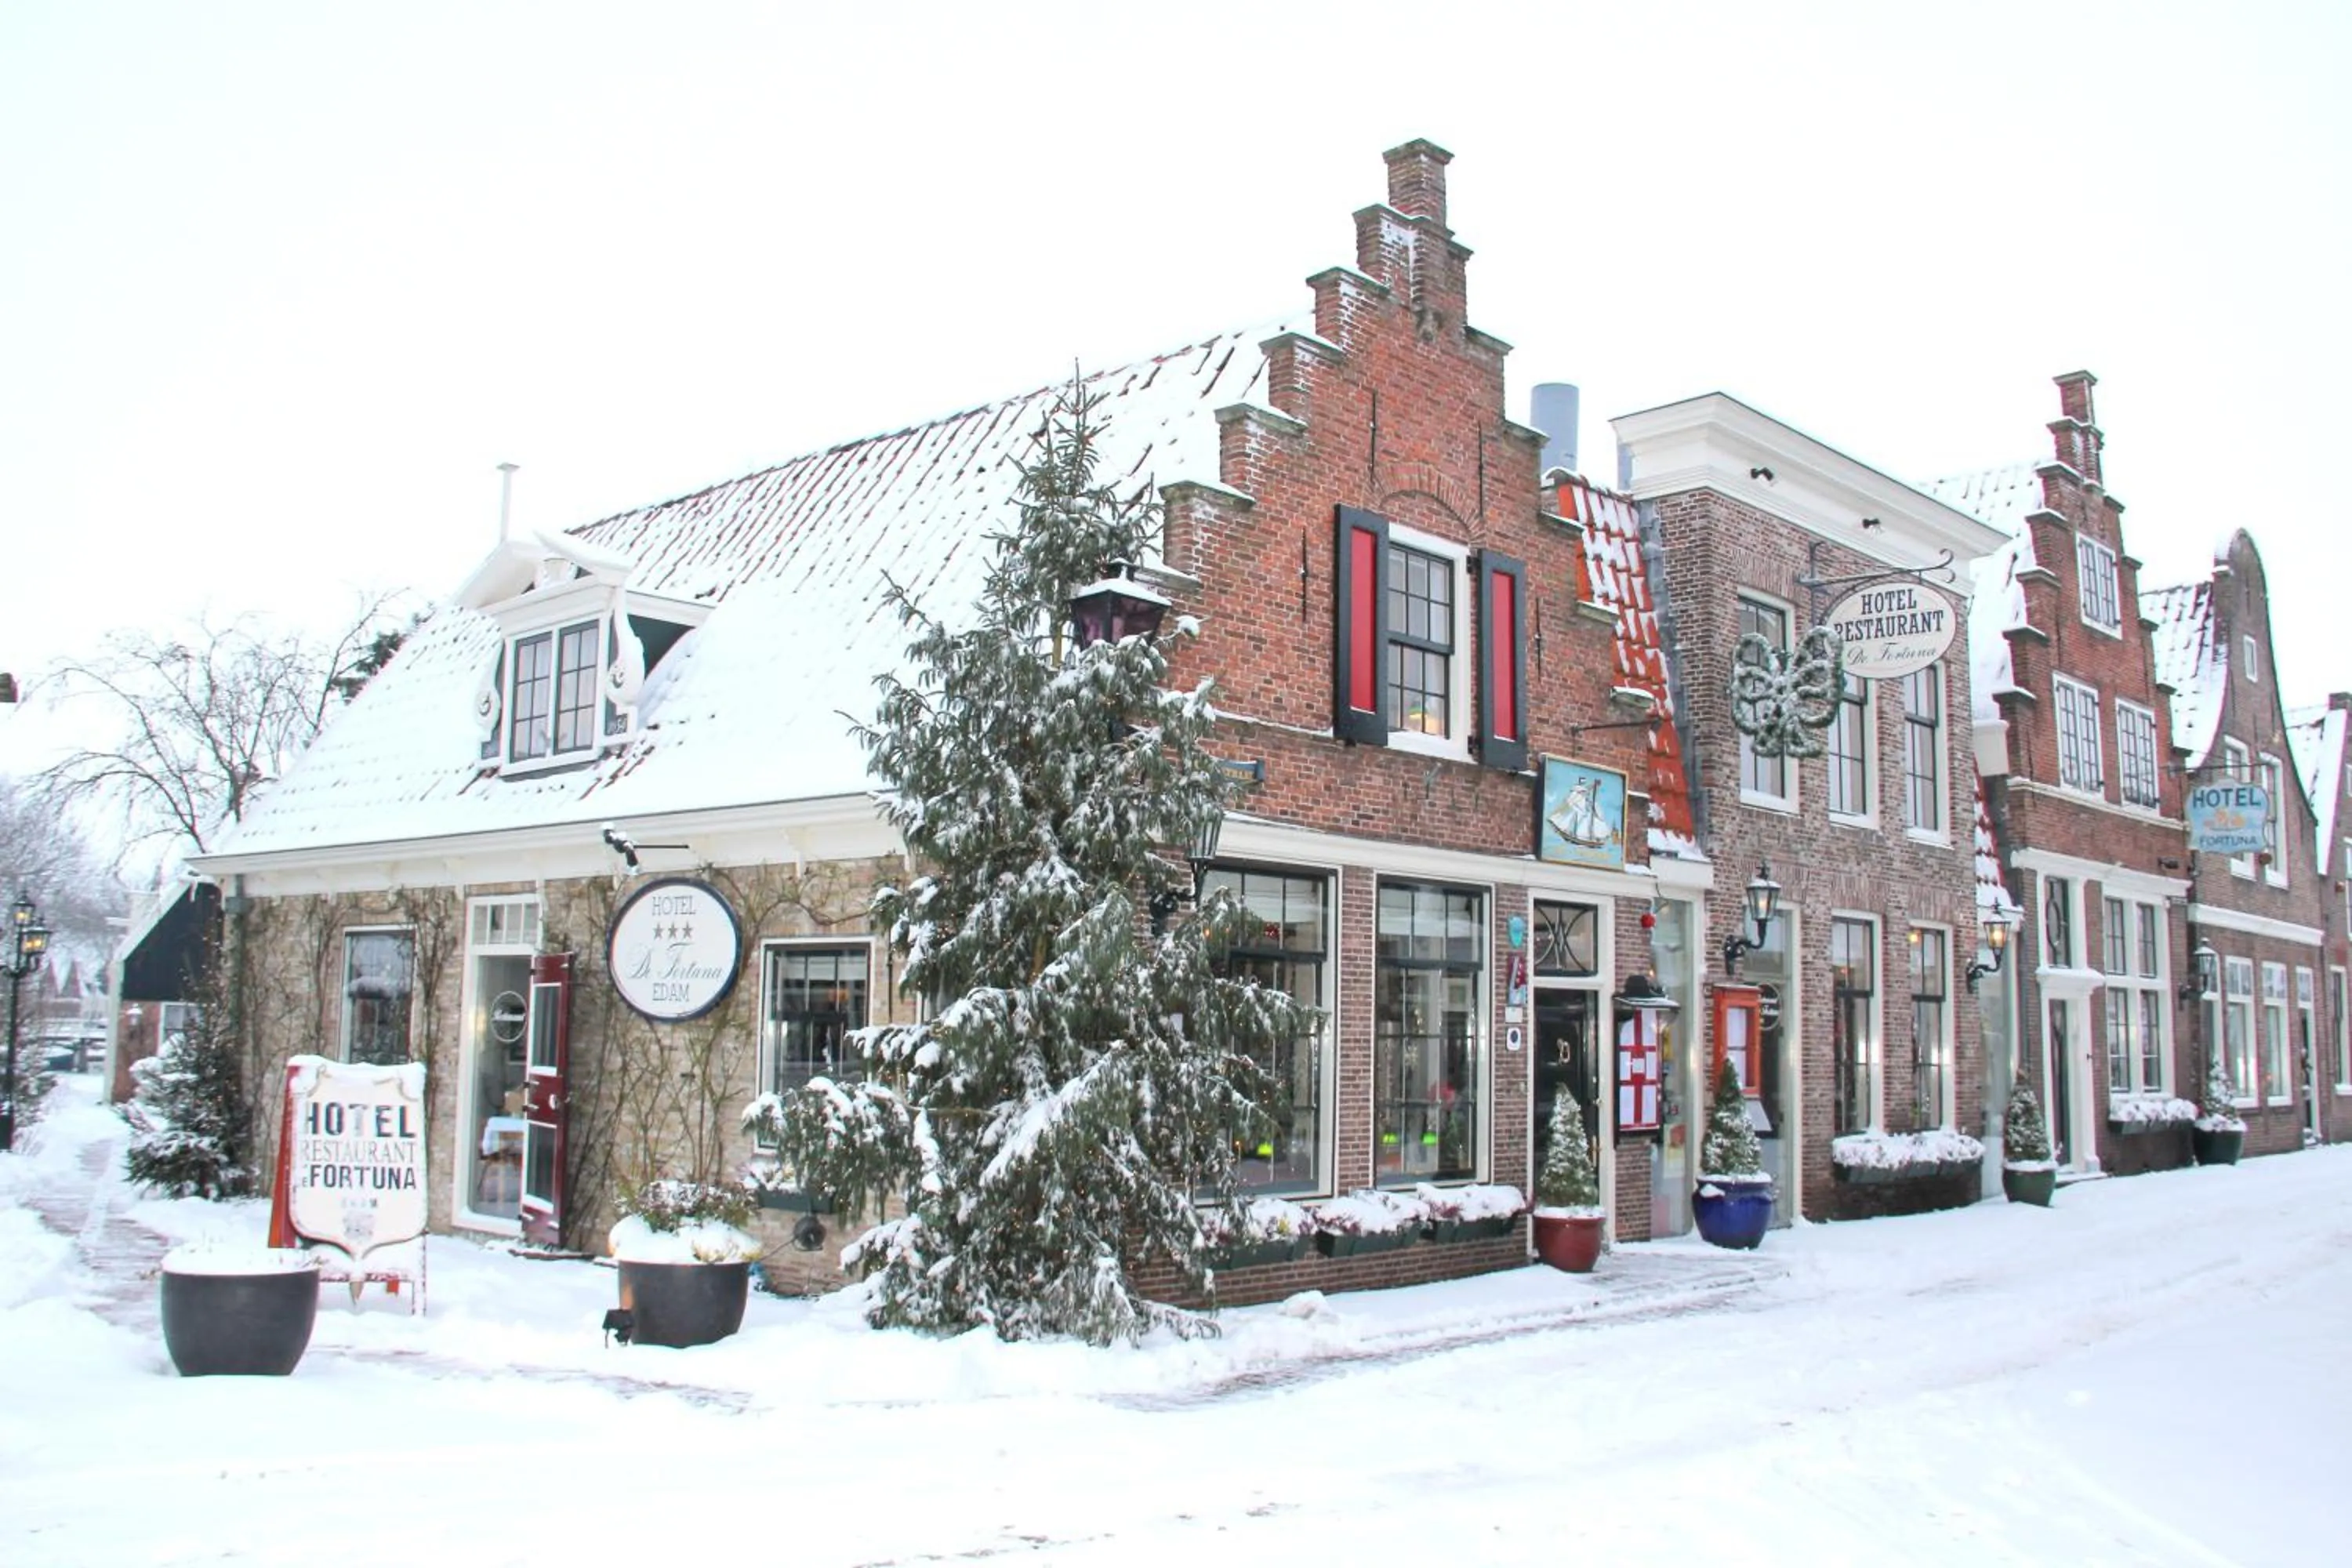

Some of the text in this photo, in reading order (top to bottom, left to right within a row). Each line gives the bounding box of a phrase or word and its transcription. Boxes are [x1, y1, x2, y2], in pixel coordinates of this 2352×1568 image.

[1860, 589, 1917, 615] HOTEL
[1834, 610, 1944, 642] RESTAURANT
[2192, 787, 2262, 808] HOTEL
[2199, 835, 2258, 847] FORTUNA
[652, 895, 696, 916] HOTEL
[652, 982, 691, 1003] EDAM
[305, 1102, 416, 1138] HOTEL
[301, 1140, 416, 1163] RESTAURANT
[309, 1164, 417, 1190] FORTUNA
